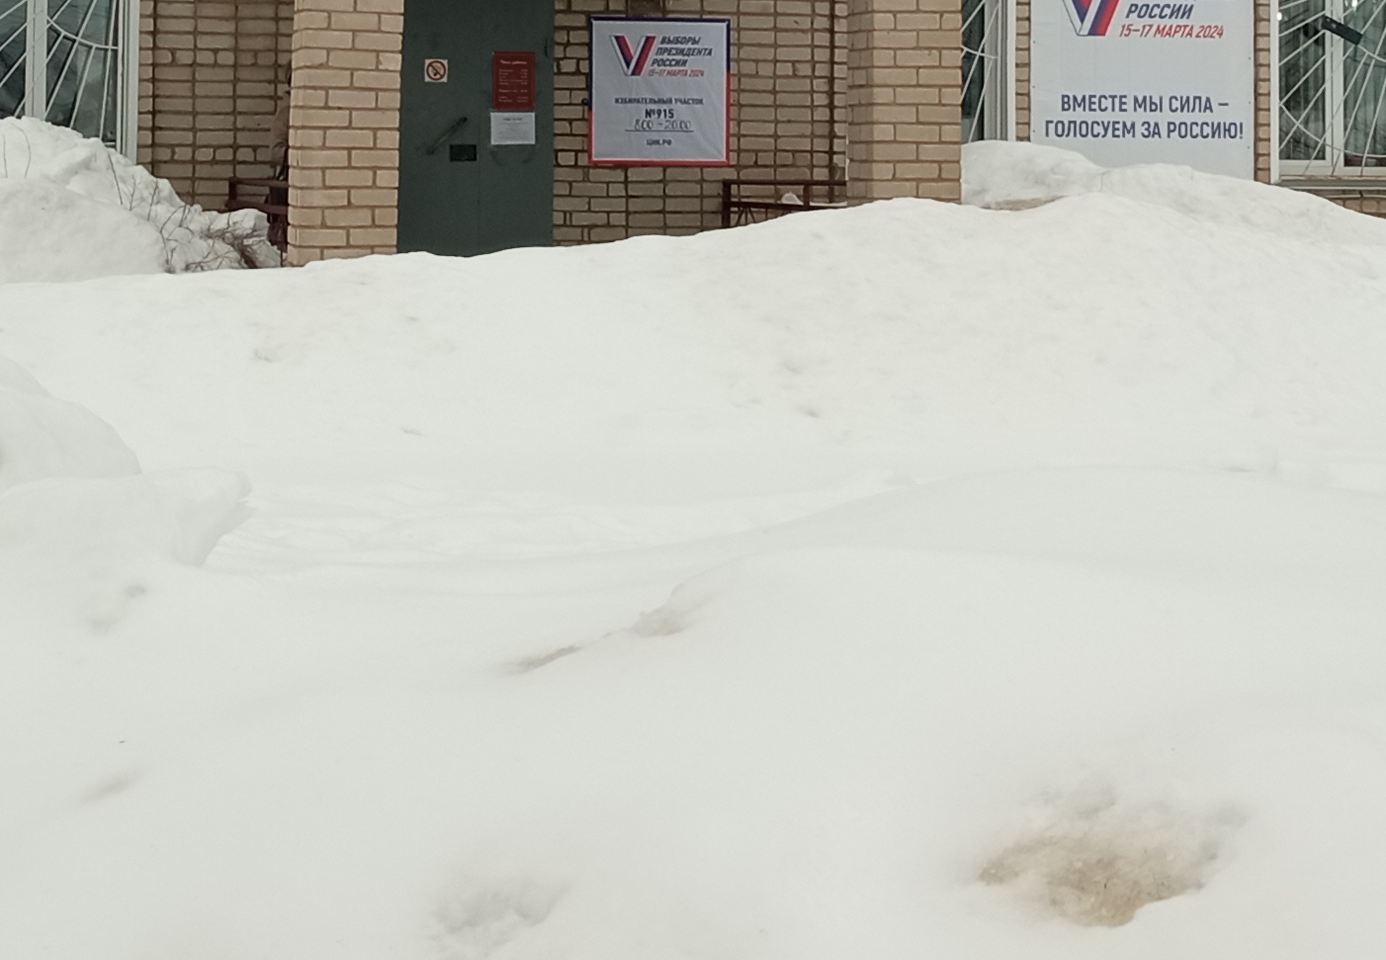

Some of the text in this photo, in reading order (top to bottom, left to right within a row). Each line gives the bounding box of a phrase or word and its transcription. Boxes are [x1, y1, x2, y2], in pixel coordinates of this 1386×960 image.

[1125, 3, 1194, 20] РОССИИ
[1153, 24, 1194, 38] МАРТА
[1195, 25, 1224, 39] 2024
[660, 36, 702, 45] ВЫБОРЫ
[655, 47, 713, 57] ПРЕЗИДЕНТА
[651, 58, 689, 67] РОССИИ
[614, 97, 673, 105] ИЗБИРАТЕЛЬНЫЙ
[1061, 94, 1128, 113] ВМЕСТЕ
[1133, 95, 1163, 113] МЫ
[1168, 96, 1214, 113] СИЛА
[1045, 120, 1244, 139] ГОЛОСУЕМ ЗА РОССИЮ!
